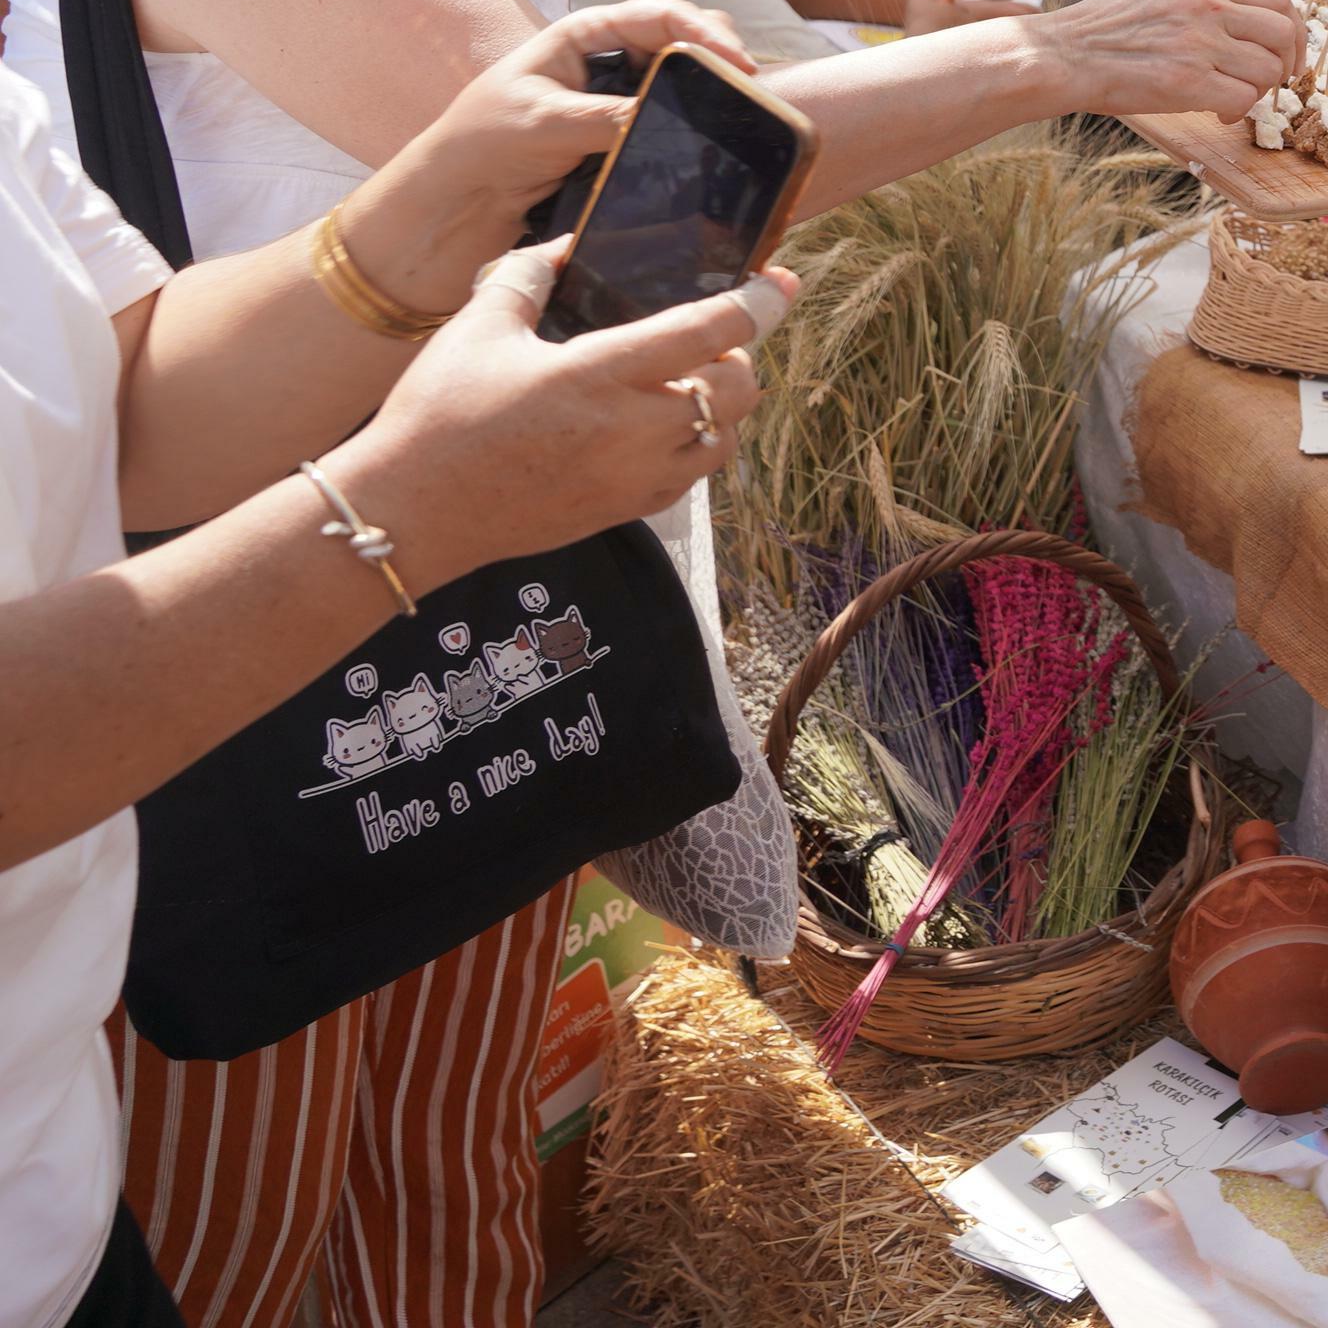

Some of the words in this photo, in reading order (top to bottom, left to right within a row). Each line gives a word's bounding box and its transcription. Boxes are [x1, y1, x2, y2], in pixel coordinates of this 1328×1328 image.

[355, 674, 372, 689] Hi
[356, 791, 440, 854] Have
[448, 780, 471, 815] a
[476, 749, 536, 798] nice
[543, 692, 606, 761] day!
[1147, 1080, 1196, 1106] ROTASI
[1152, 1060, 1224, 1101] KARAKILÇIK
